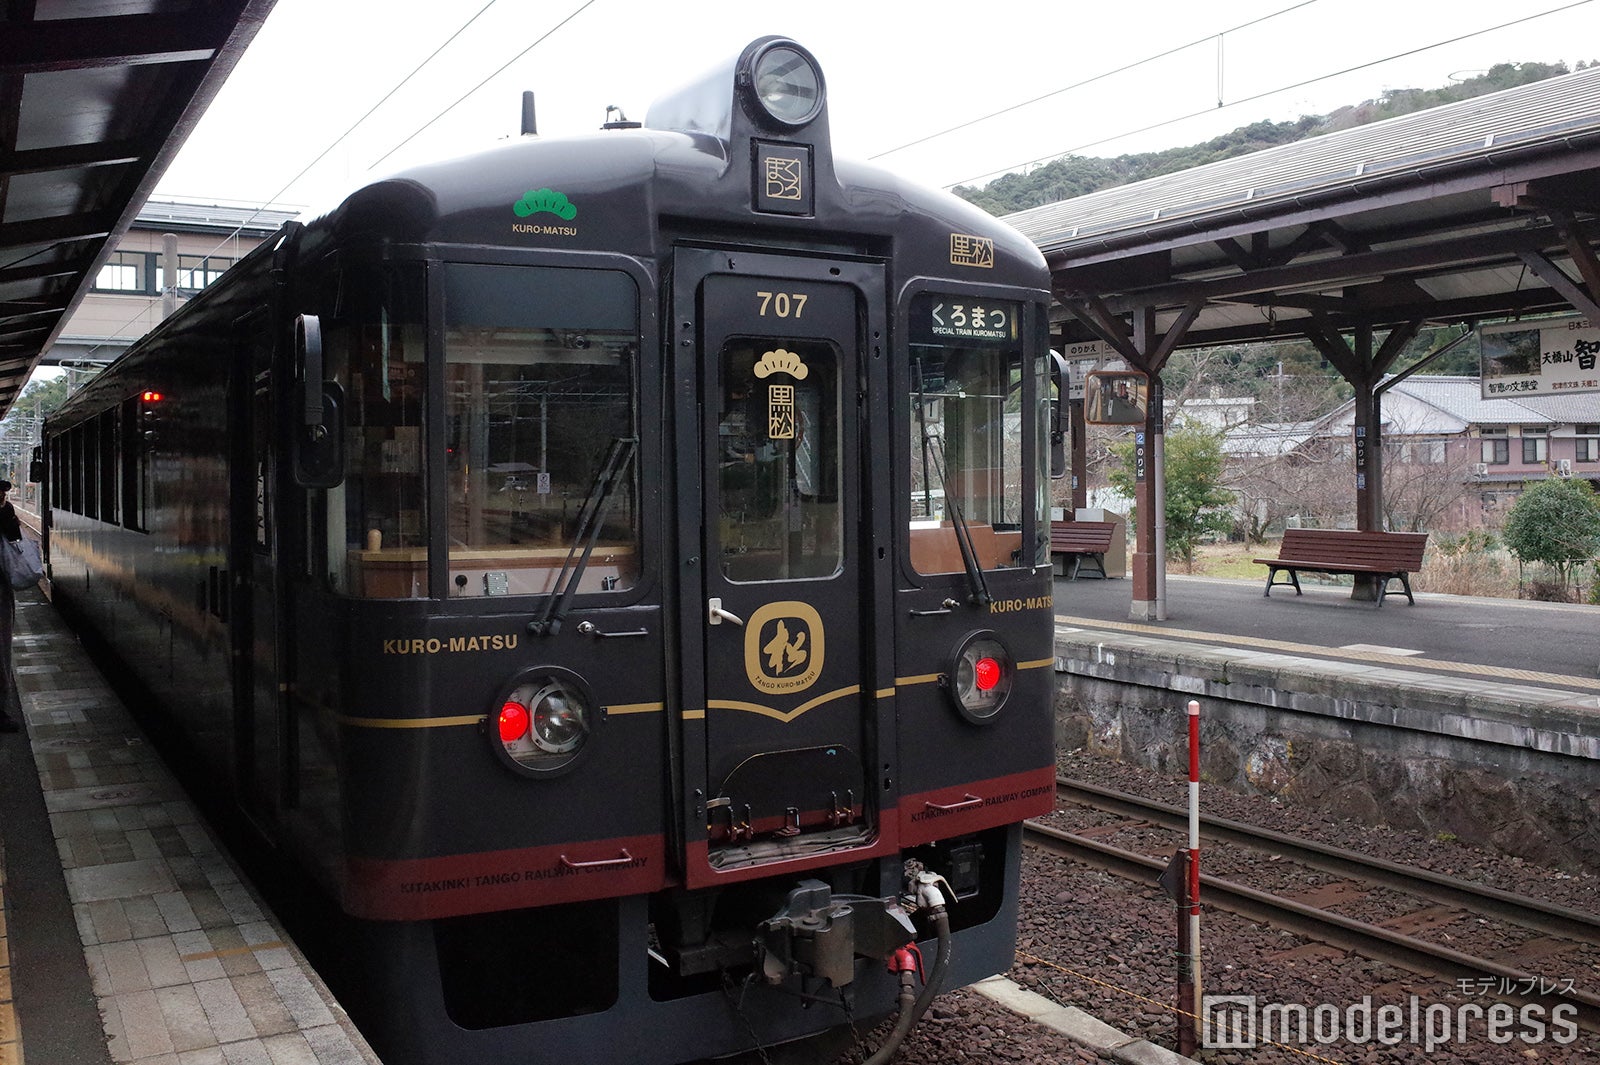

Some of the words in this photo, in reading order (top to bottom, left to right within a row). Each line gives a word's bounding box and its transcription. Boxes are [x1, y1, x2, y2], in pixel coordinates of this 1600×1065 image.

[512, 224, 577, 236] KURO-MATSU
[950, 233, 994, 268] 黒松
[757, 291, 808, 318] 707
[932, 303, 1006, 328] くろまつ
[1568, 320, 1594, 331] 日本三
[932, 326, 955, 335] SPECIAL
[956, 328, 973, 336] TRAIN
[973, 329, 1006, 338] KUROMATSU
[1071, 344, 1097, 354] のりかえ
[1573, 339, 1600, 370] 智
[769, 385, 794, 438] 黒松
[990, 595, 1053, 614] KURO-MATS
[383, 634, 518, 655] KURO-MATSU
[763, 619, 807, 676] 松
[755, 675, 775, 689] TANGO
[777, 671, 816, 689] KURO-MATSU
[985, 792, 1019, 806] RAILWAY
[1021, 785, 1053, 800] COMPAN
[401, 877, 470, 894] KITAKINKI
[475, 873, 521, 887] TANGO
[524, 865, 582, 881] RAILWAY
